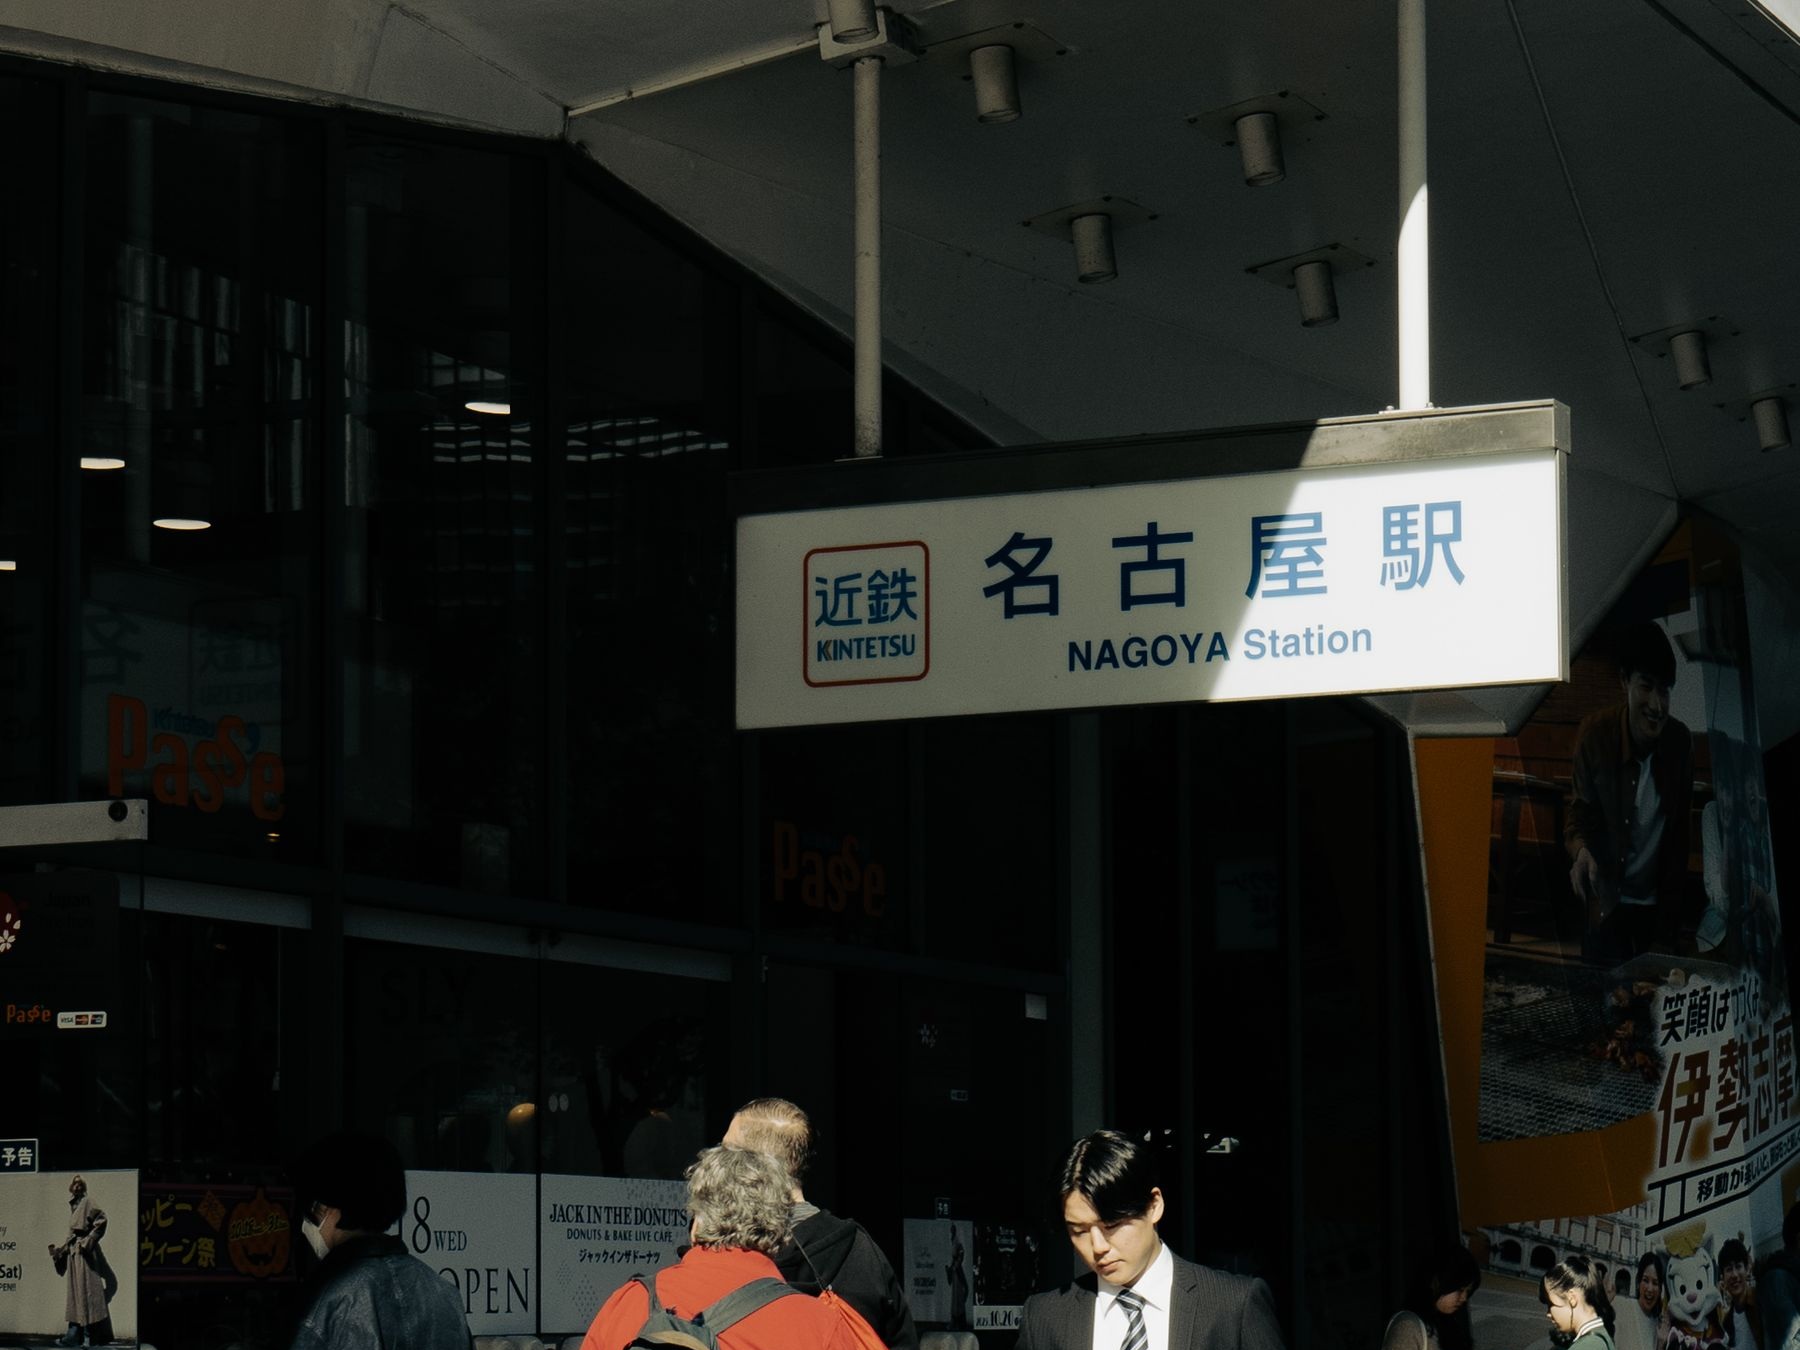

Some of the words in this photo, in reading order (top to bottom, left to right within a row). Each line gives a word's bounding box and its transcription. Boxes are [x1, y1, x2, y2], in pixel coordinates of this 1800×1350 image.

[982, 500, 1466, 619] 名古屋駅
[814, 566, 918, 628] 近鉄
[815, 634, 916, 662] KINTETSU
[1068, 631, 1230, 672] NAGOYA
[1243, 623, 1373, 660] Station
[1, 1146, 34, 1167] 予告
[412, 1196, 431, 1254] 8
[434, 1230, 468, 1252] WED
[549, 1203, 584, 1224] JACK
[586, 1205, 602, 1224] IN
[604, 1206, 632, 1225] THE
[634, 1207, 688, 1228] DONUTS
[566, 1228, 602, 1241] DONUTS
[604, 1230, 610, 1241] &
[612, 1230, 633, 1242] BAKE
[635, 1231, 652, 1242] LIVE
[578, 1249, 662, 1265] ジャックインザドーナツ
